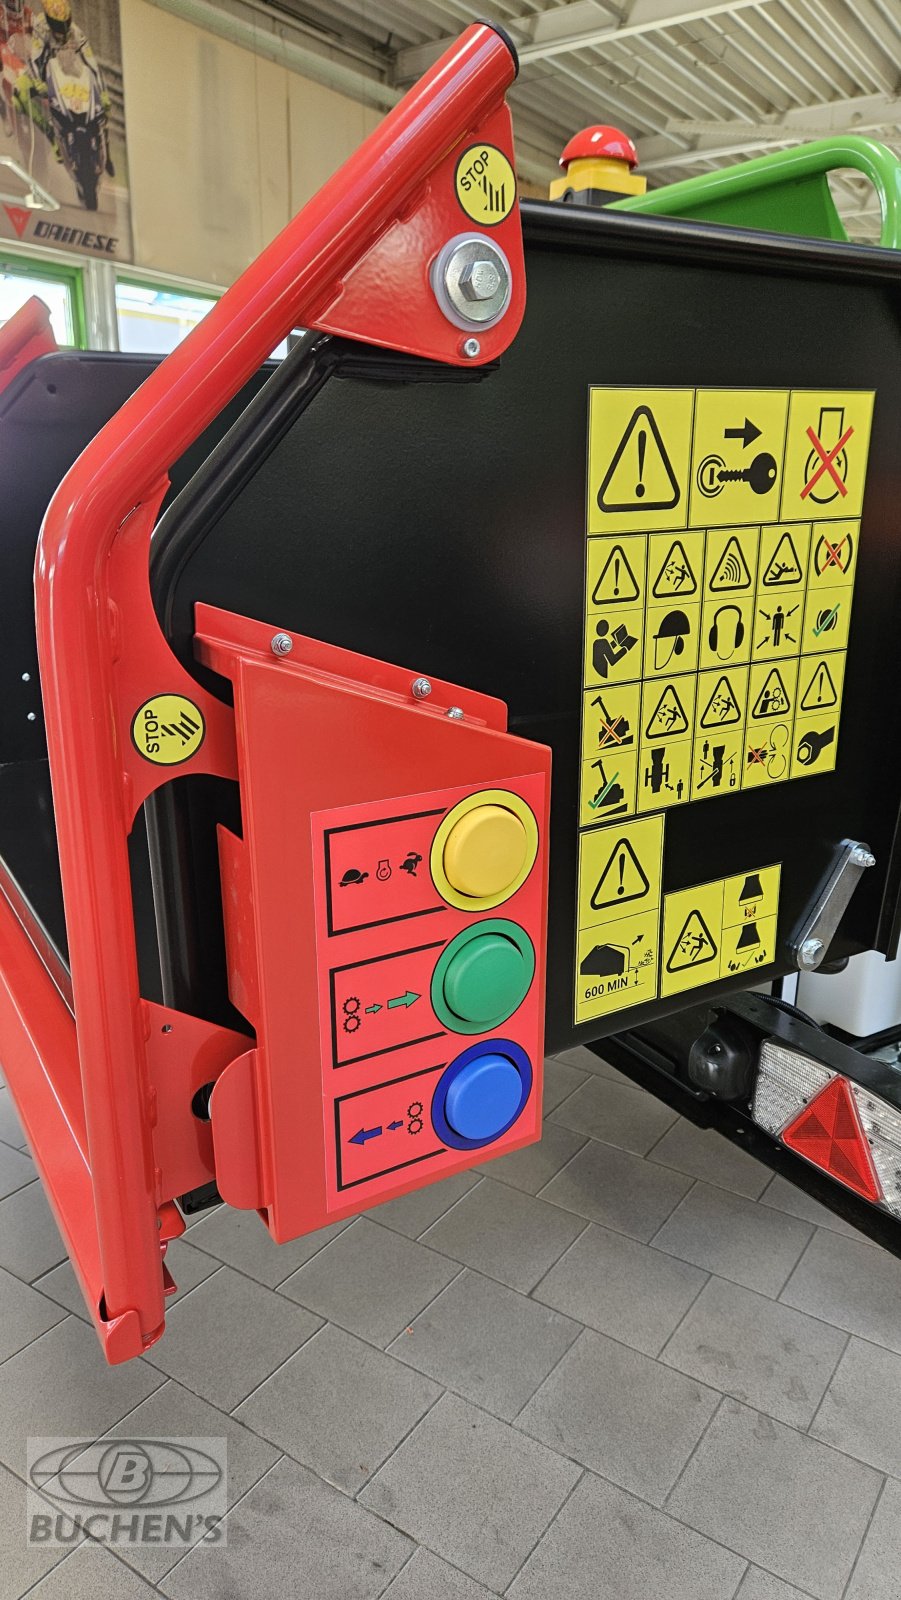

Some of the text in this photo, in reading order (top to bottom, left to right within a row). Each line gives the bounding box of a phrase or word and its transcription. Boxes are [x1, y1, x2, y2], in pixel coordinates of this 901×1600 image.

[460, 151, 490, 191] STOP
[145, 709, 160, 753] STOP
[585, 976, 628, 999] 600 MIN
